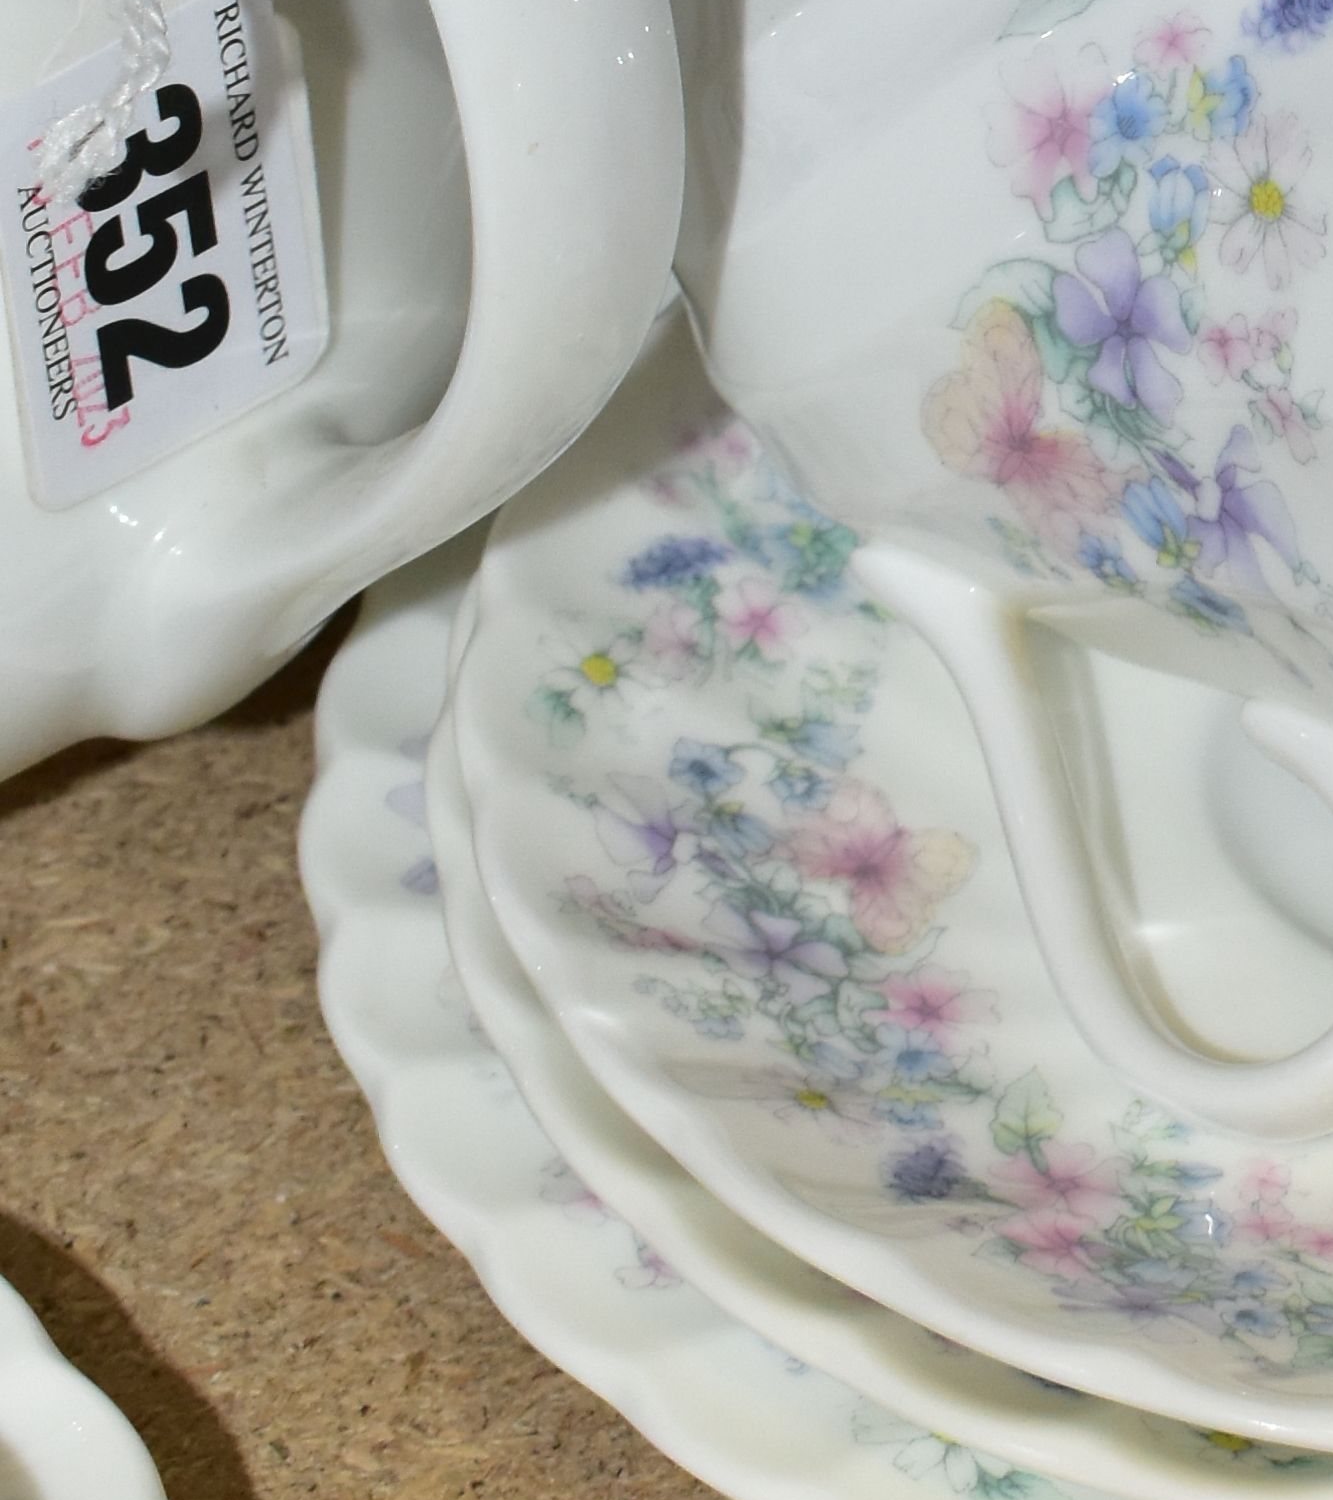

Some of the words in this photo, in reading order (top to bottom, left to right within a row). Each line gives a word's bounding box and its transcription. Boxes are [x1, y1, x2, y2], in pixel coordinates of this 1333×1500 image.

[17, 185, 79, 422] AUCTIONEERS
[76, 83, 230, 412] 352
[240, 164, 290, 367] WINTERTON
